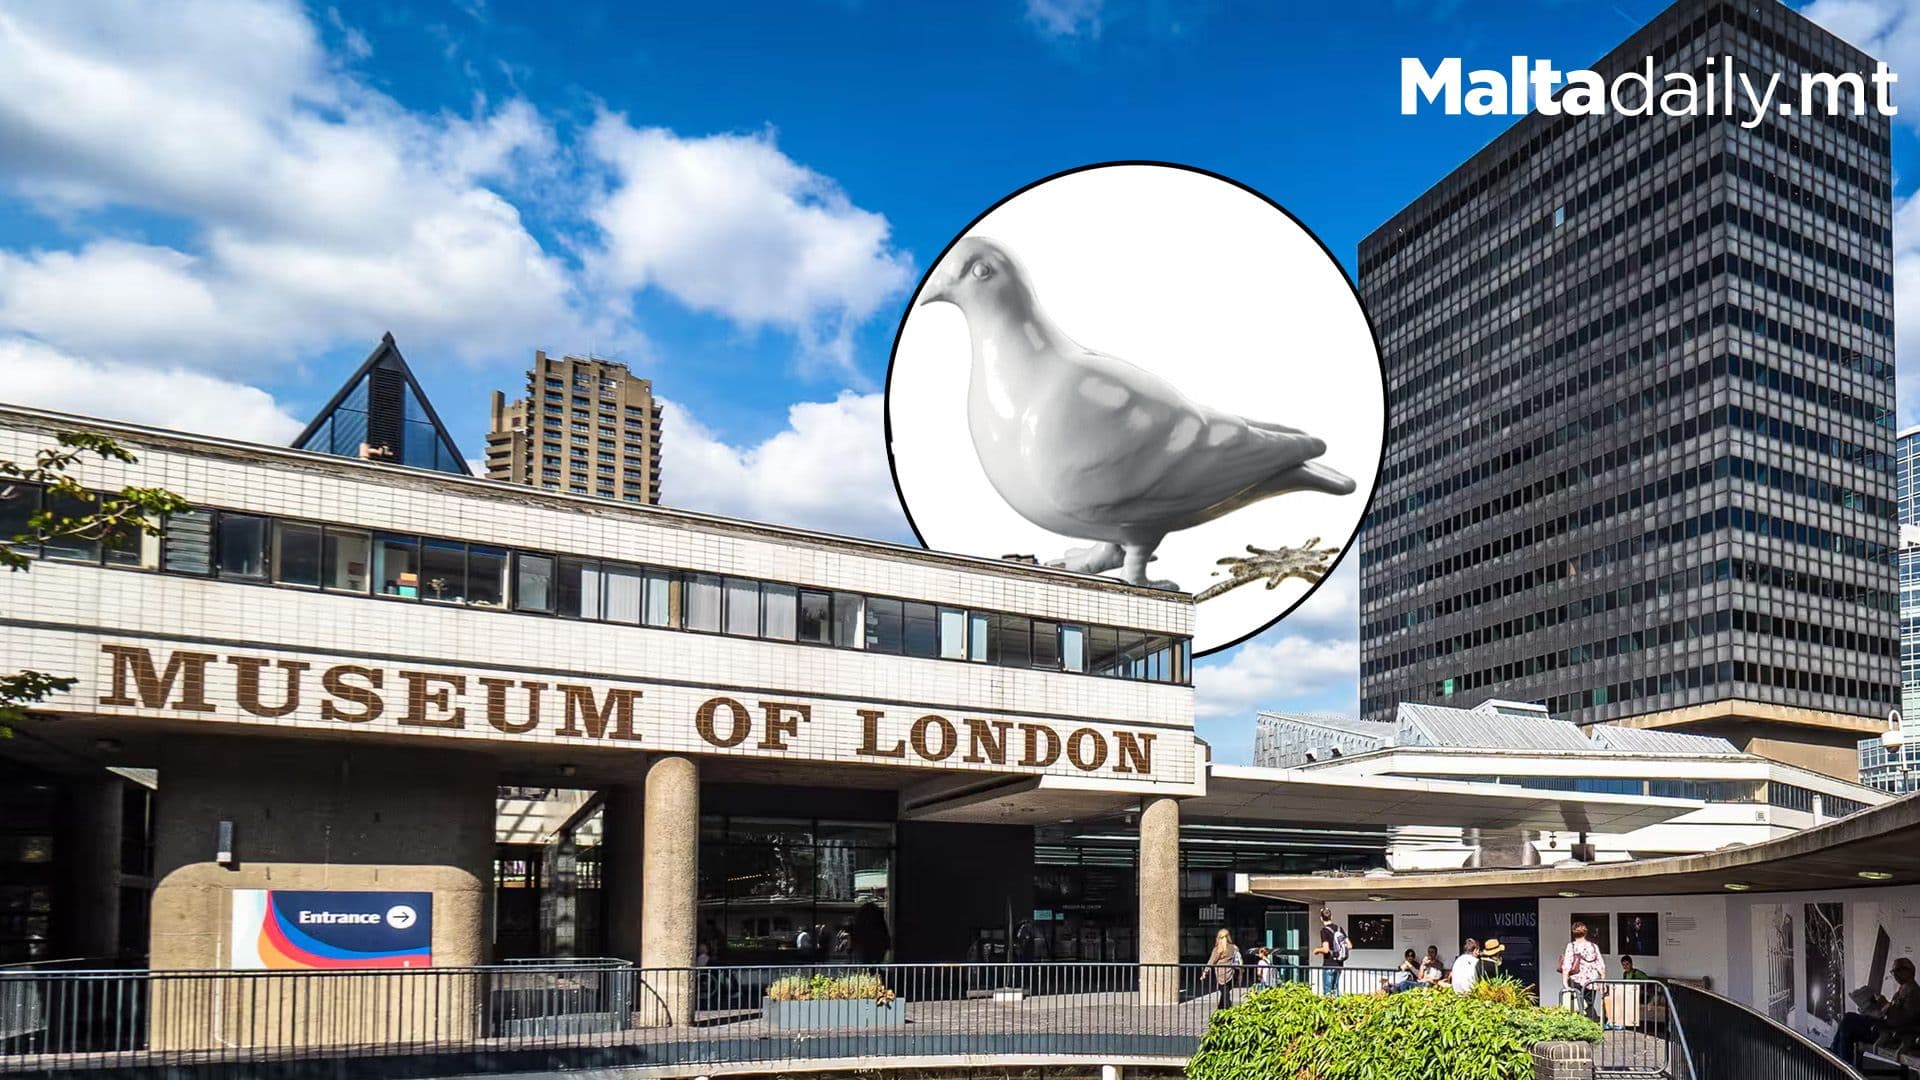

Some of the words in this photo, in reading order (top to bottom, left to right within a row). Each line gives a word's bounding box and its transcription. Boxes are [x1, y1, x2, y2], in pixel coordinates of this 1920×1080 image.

[100, 644, 643, 741] MUSEUM
[695, 697, 812, 751] OF
[856, 709, 1158, 774] LONDON
[299, 910, 381, 925] Entrance
[1494, 912, 1537, 927] VISIONS
